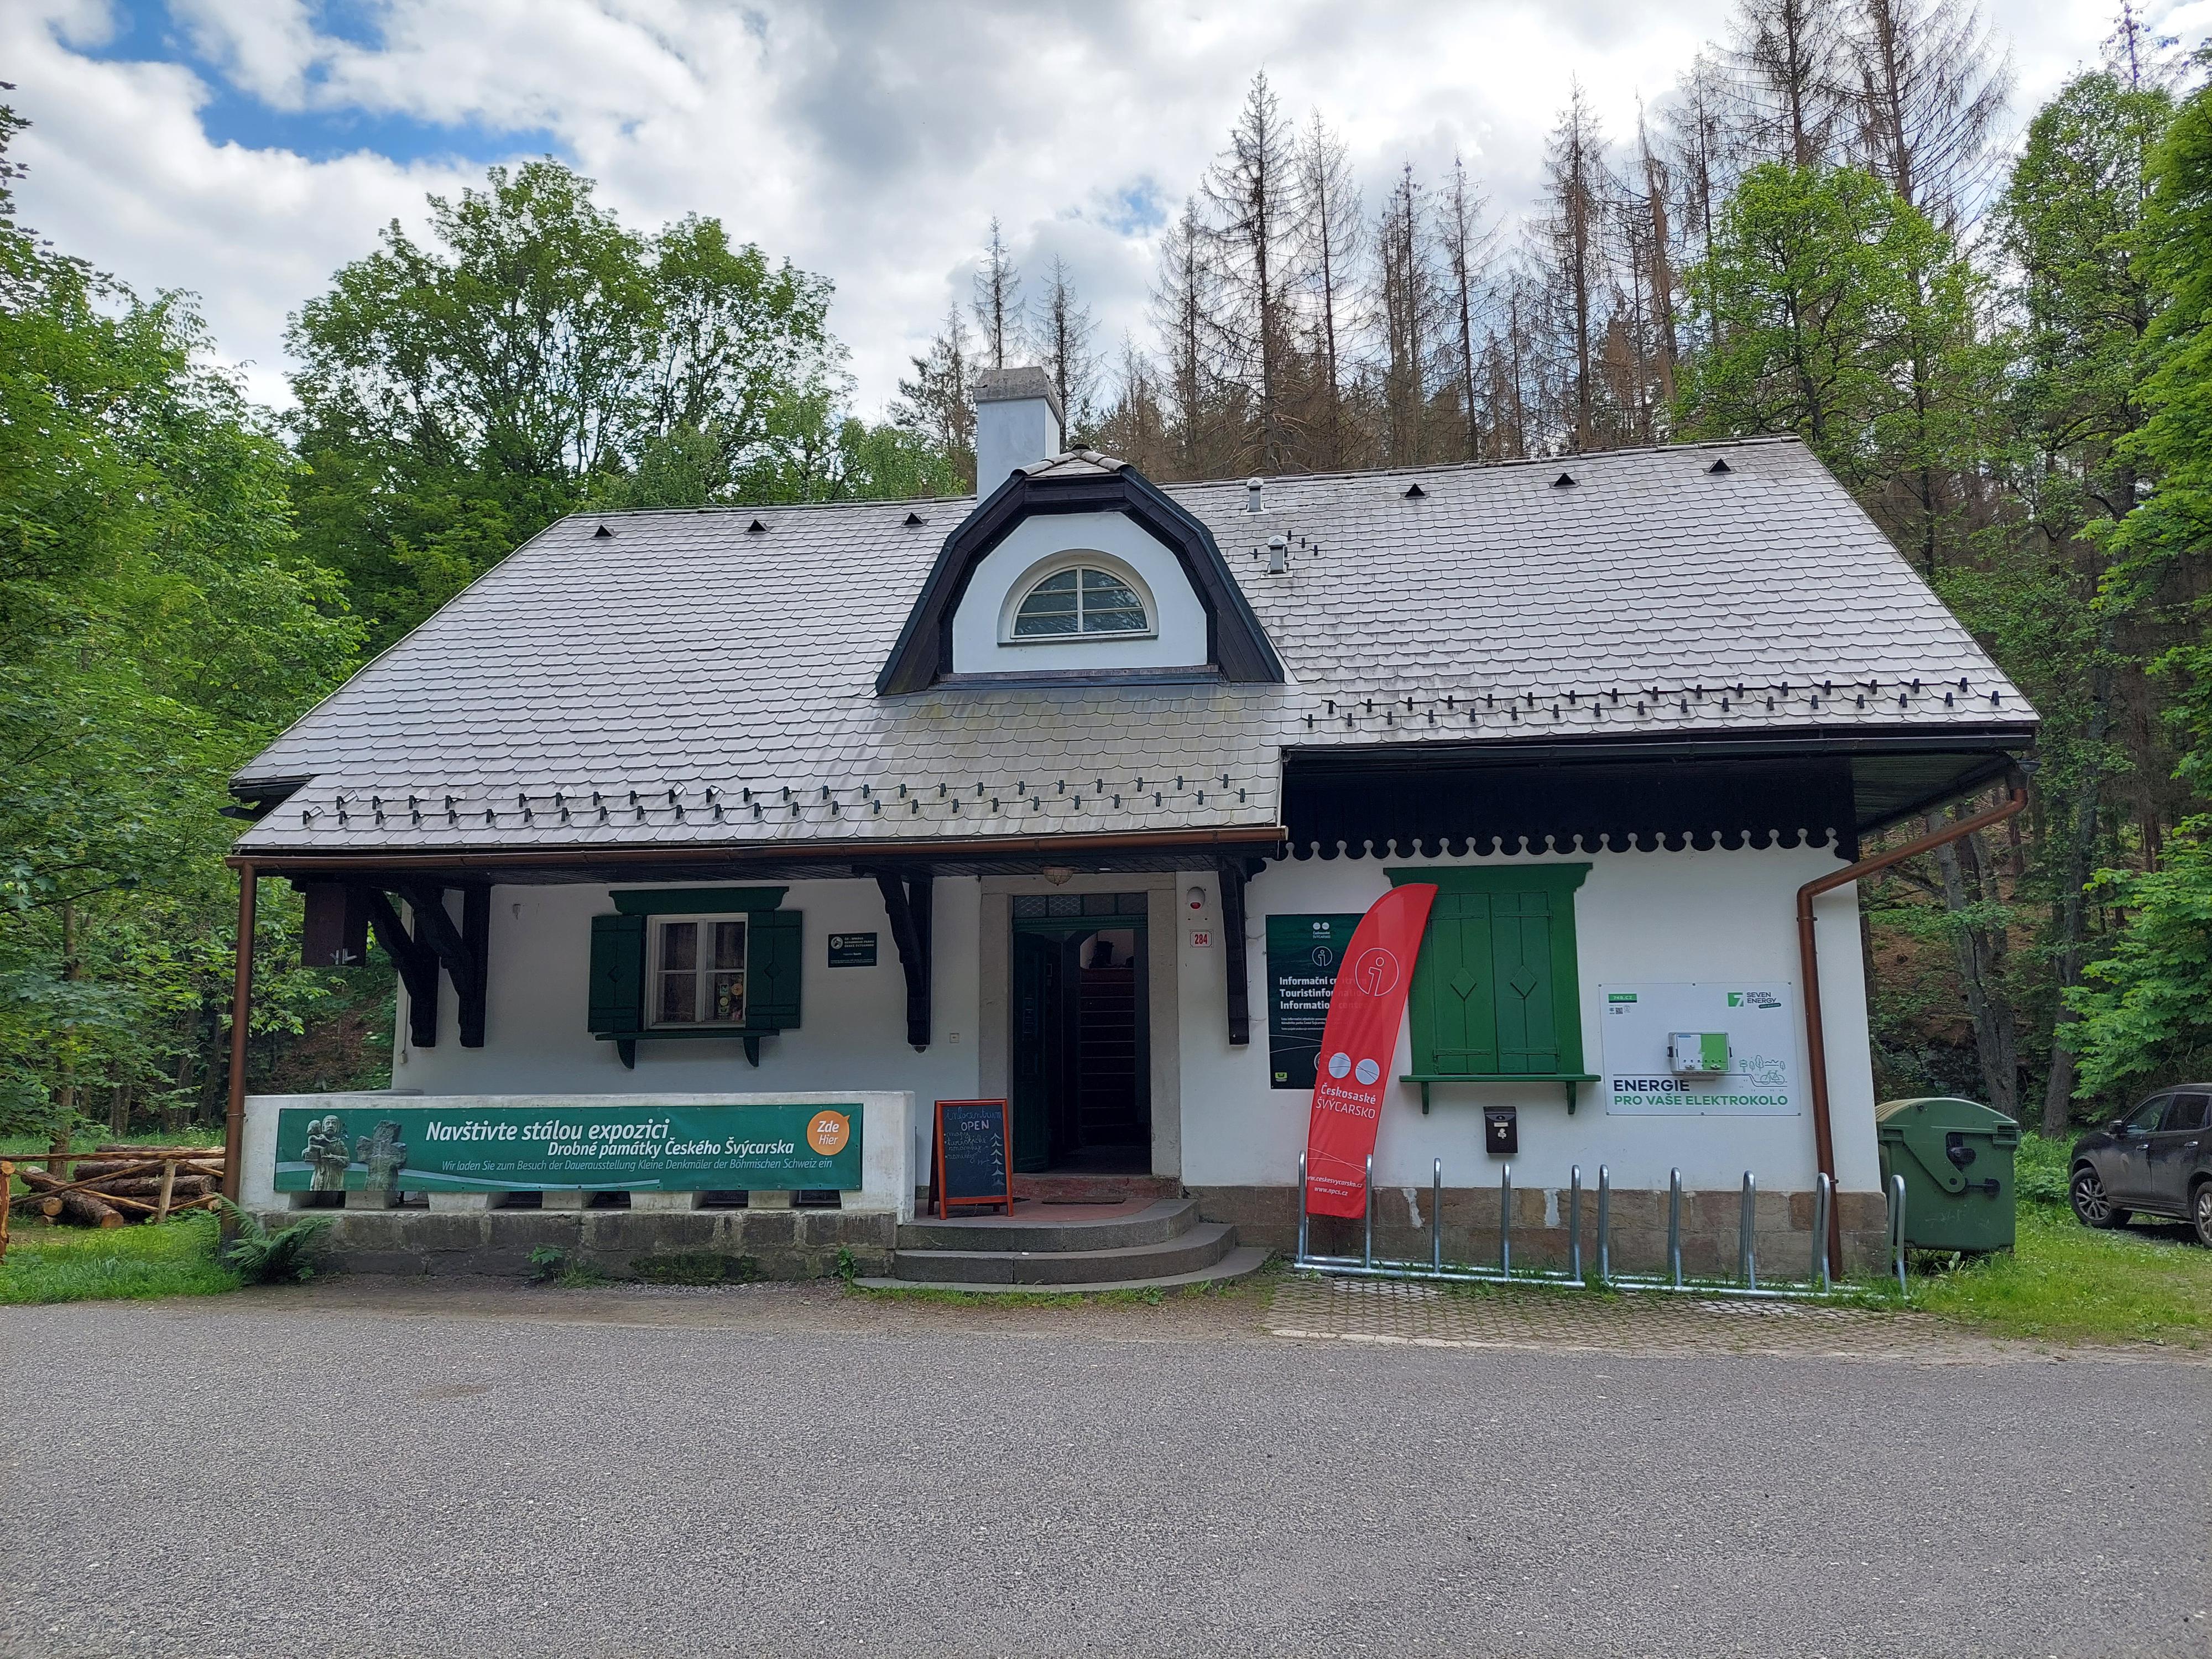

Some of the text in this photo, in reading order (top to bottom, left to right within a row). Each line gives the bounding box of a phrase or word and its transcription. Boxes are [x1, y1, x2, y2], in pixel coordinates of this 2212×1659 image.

[1194, 934, 1208, 945] 284
[1279, 976, 1328, 985] Informační
[1280, 1000, 1331, 1009] Informatio
[1613, 1079, 1690, 1092] ENERGIE
[1321, 1082, 1376, 1104] Českosaské
[1614, 1093, 1788, 1106] PRO VAŠE ELEKTROKOLO
[1316, 1096, 1375, 1119] ŠVÝCARSKO
[425, 1118, 670, 1145] Navštivte stálou expozici
[817, 1120, 839, 1133] Zde
[961, 1119, 989, 1131] OPEN
[818, 1134, 838, 1145] Hier
[547, 1136, 795, 1159] Drobné památky Českého Švýcarska
[442, 1161, 456, 1171] Wir
[457, 1160, 481, 1171] laden
[482, 1161, 495, 1171] Sie
[517, 1160, 546, 1170] Besuch
[549, 1160, 564, 1170] der
[564, 1159, 636, 1172] Dauerausstellung
[638, 1159, 664, 1170] Kleine
[665, 1159, 713, 1170] Denkmäler
[713, 1159, 729, 1169] der
[730, 1158, 781, 1168] Böhmischen
[782, 1157, 817, 1168] Schweiz
[818, 1158, 832, 1168] ein
[1314, 1186, 1348, 1196] www.npcs.cz
